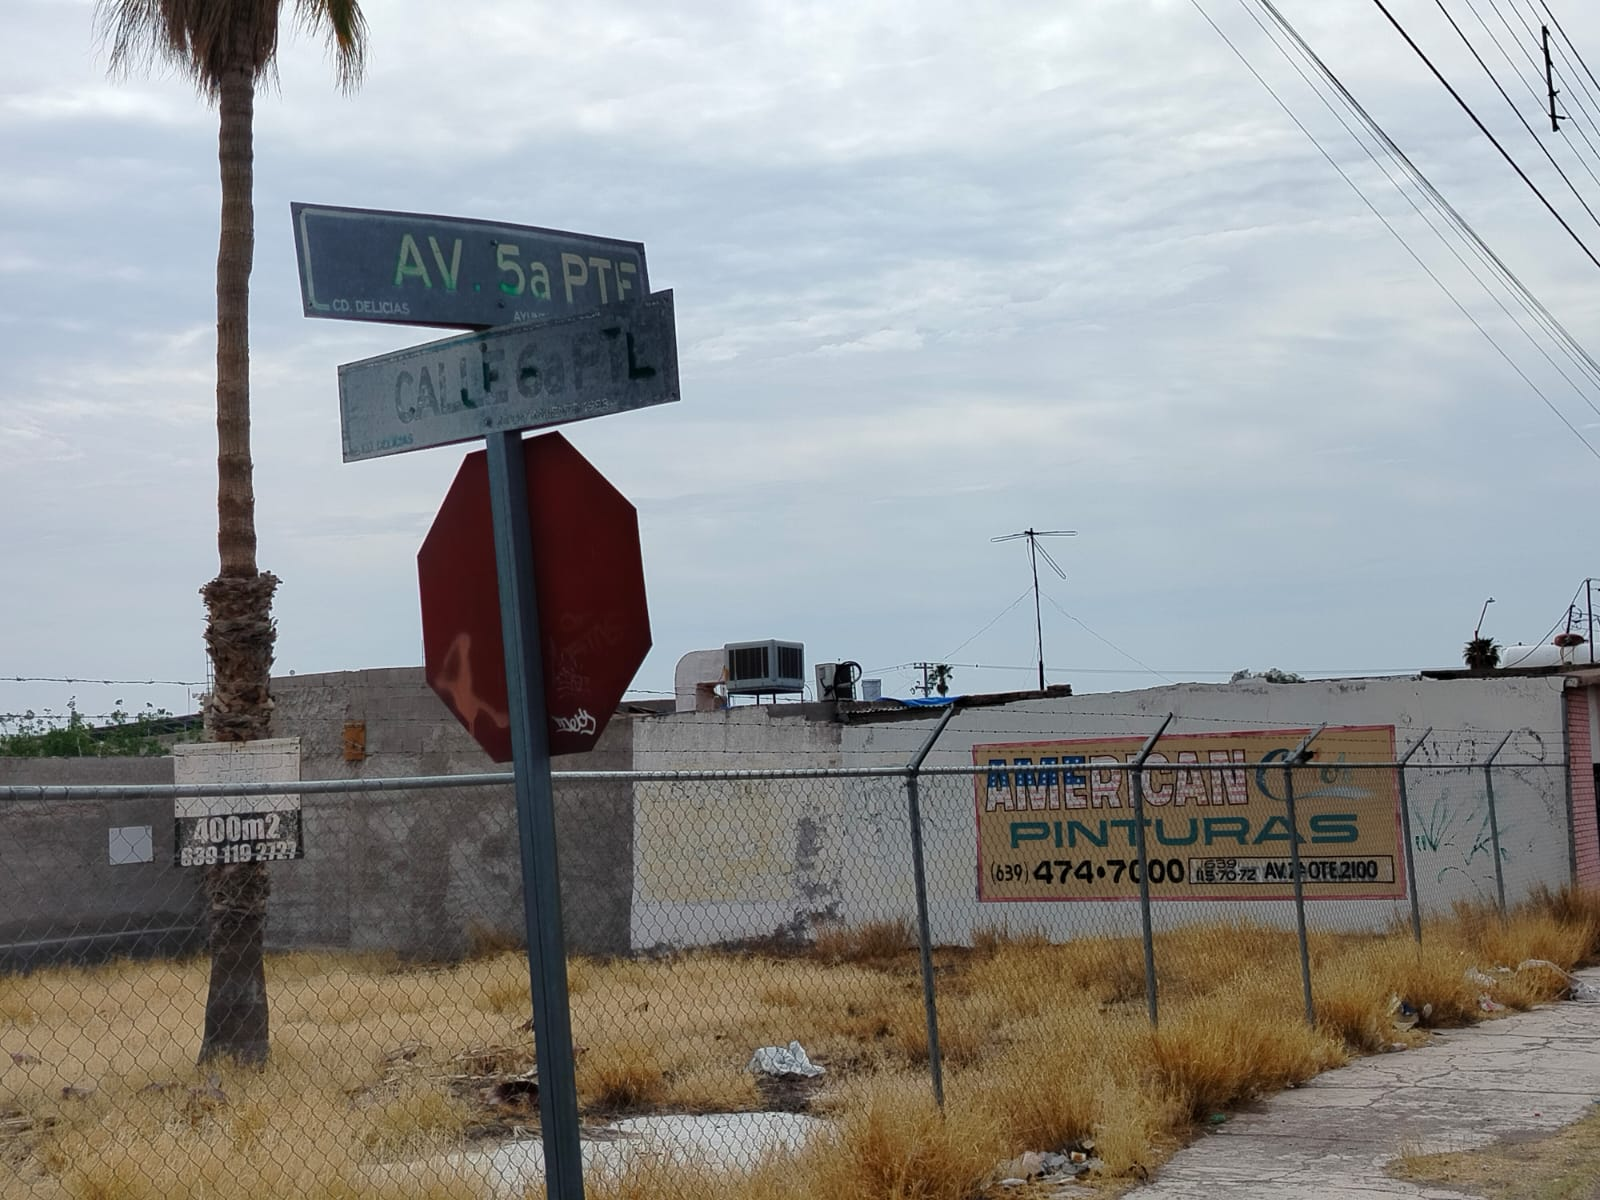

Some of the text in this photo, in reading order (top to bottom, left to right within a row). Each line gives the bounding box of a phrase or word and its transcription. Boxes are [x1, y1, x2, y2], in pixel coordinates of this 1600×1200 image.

[497, 243, 551, 300] 5a
[332, 298, 411, 315] CD. DELICIAS
[985, 750, 1249, 812] AMERICAN
[193, 813, 281, 844] 400m2
[1009, 813, 1359, 848] PINTURAS
[220, 844, 252, 864] 119
[990, 862, 1029, 885] (639)
